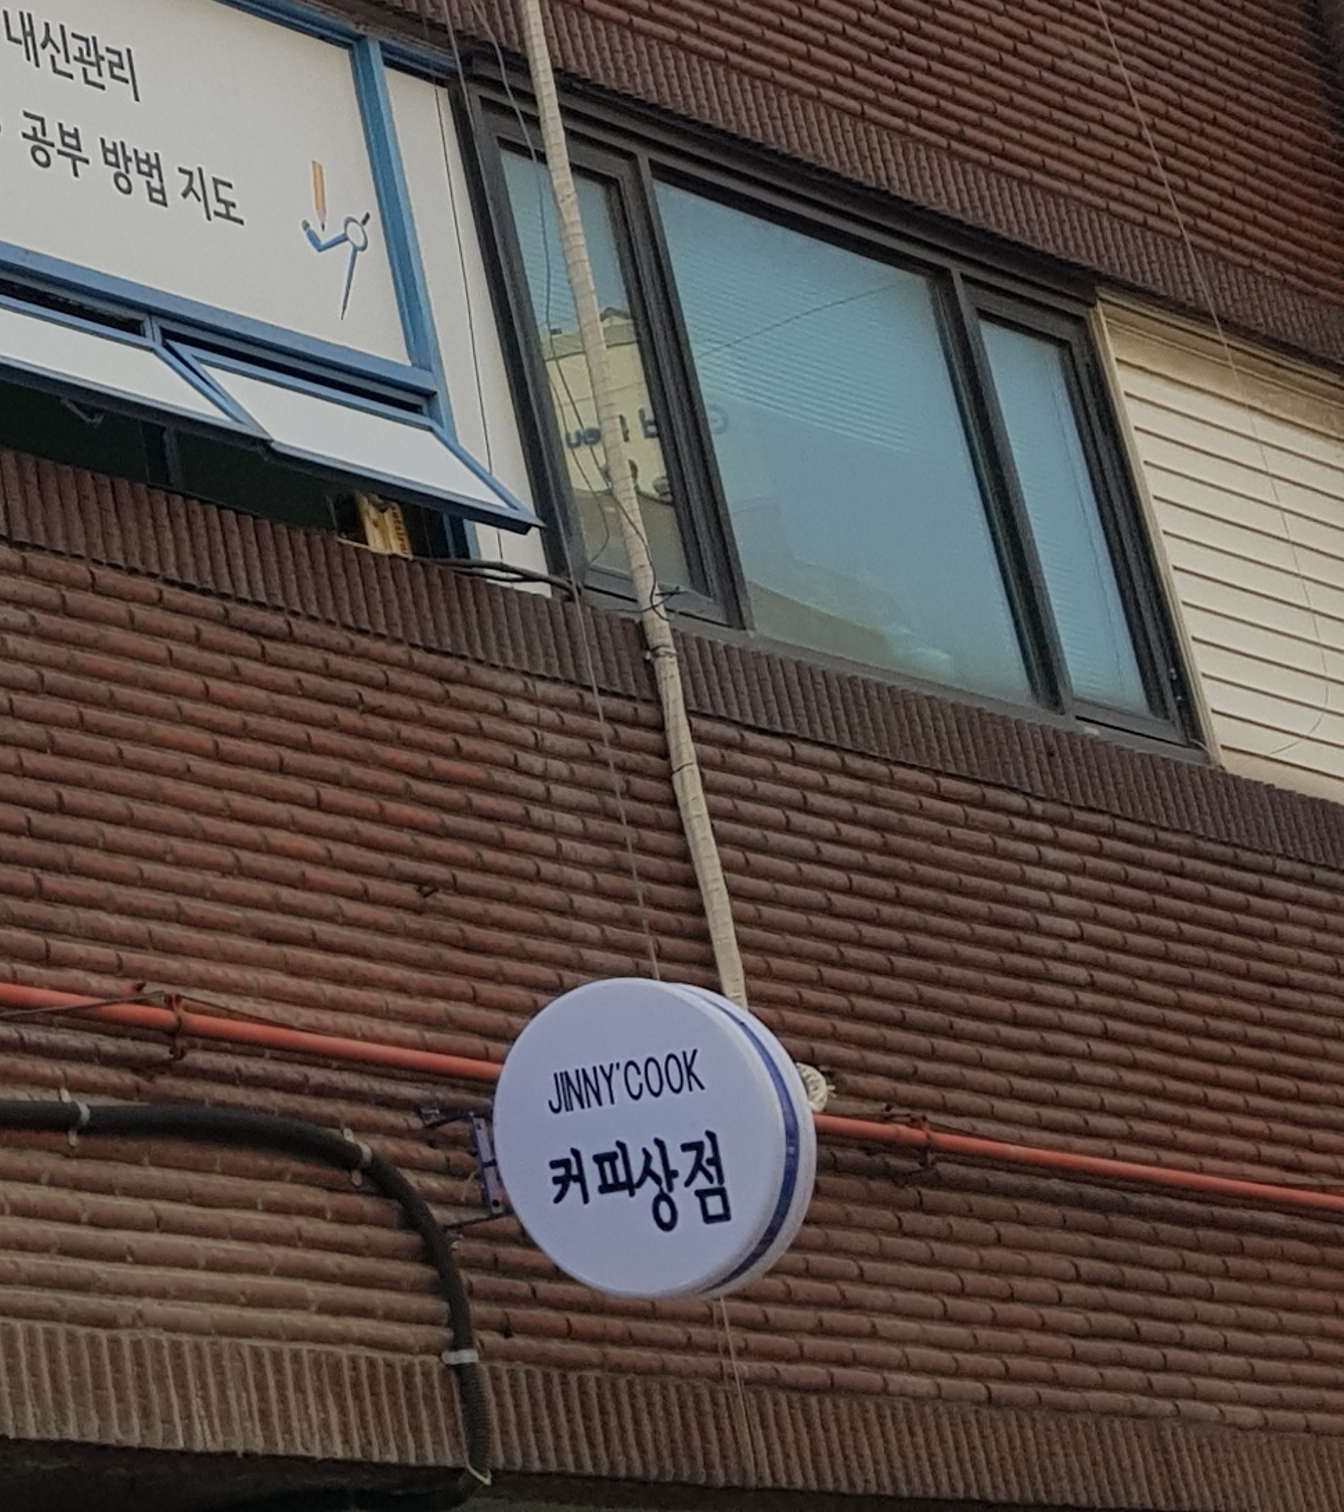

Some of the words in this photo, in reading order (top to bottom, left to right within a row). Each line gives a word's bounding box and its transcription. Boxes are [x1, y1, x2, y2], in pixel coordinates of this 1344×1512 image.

[2, 8, 141, 102] 내신관리
[21, 109, 89, 178] 공부
[100, 136, 168, 208] 방법
[177, 165, 245, 226] 지도
[548, 1129, 732, 1233] 커피상점
